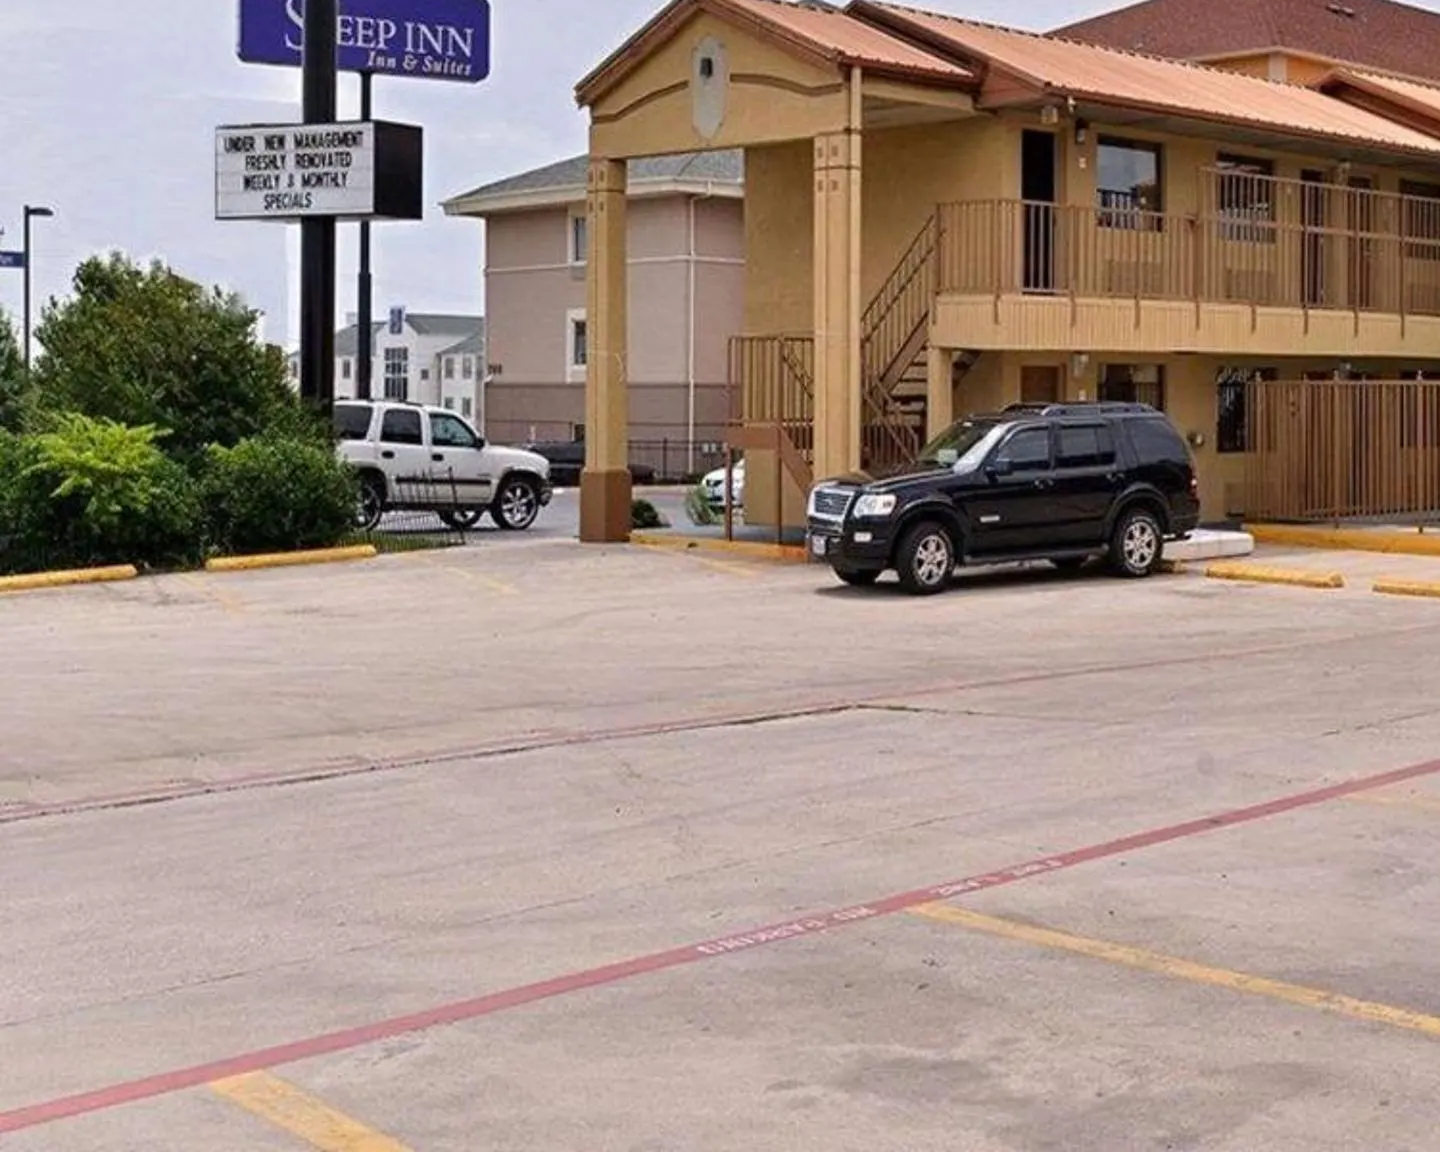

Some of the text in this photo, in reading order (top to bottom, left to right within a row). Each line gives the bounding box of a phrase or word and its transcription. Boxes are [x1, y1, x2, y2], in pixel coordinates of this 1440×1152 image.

[403, 21, 475, 58] INN
[366, 50, 473, 77] Inn & Suites
[223, 130, 364, 153] UNDER NEW MANAGEMENT
[244, 150, 353, 171] FRESHLY RENOVATED
[242, 173, 281, 190] WEEKLY
[301, 170, 349, 188] MONTHLY
[263, 191, 314, 210] SPECIALS
